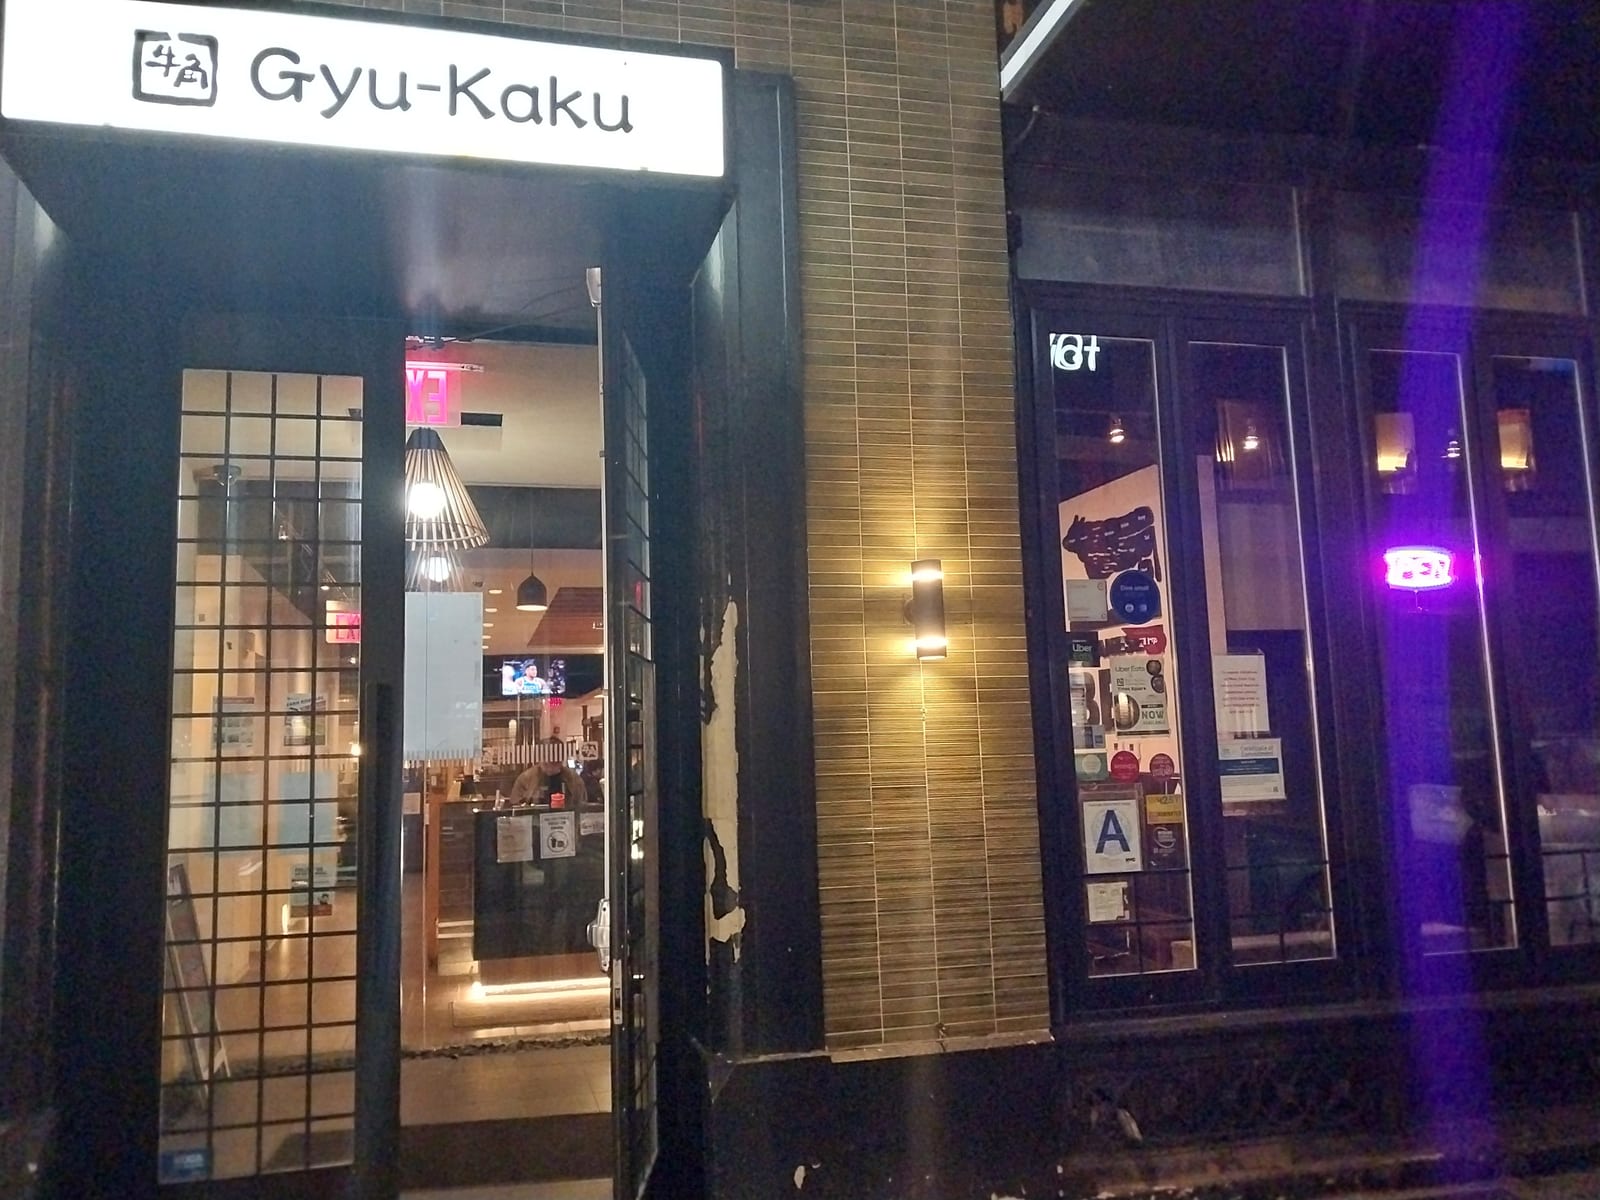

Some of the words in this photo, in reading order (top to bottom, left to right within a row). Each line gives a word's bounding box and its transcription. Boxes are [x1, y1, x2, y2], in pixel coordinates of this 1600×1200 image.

[250, 46, 633, 133] Gyu-Kaku
[1141, 710, 1164, 720] NOW
[1095, 809, 1131, 854] A
